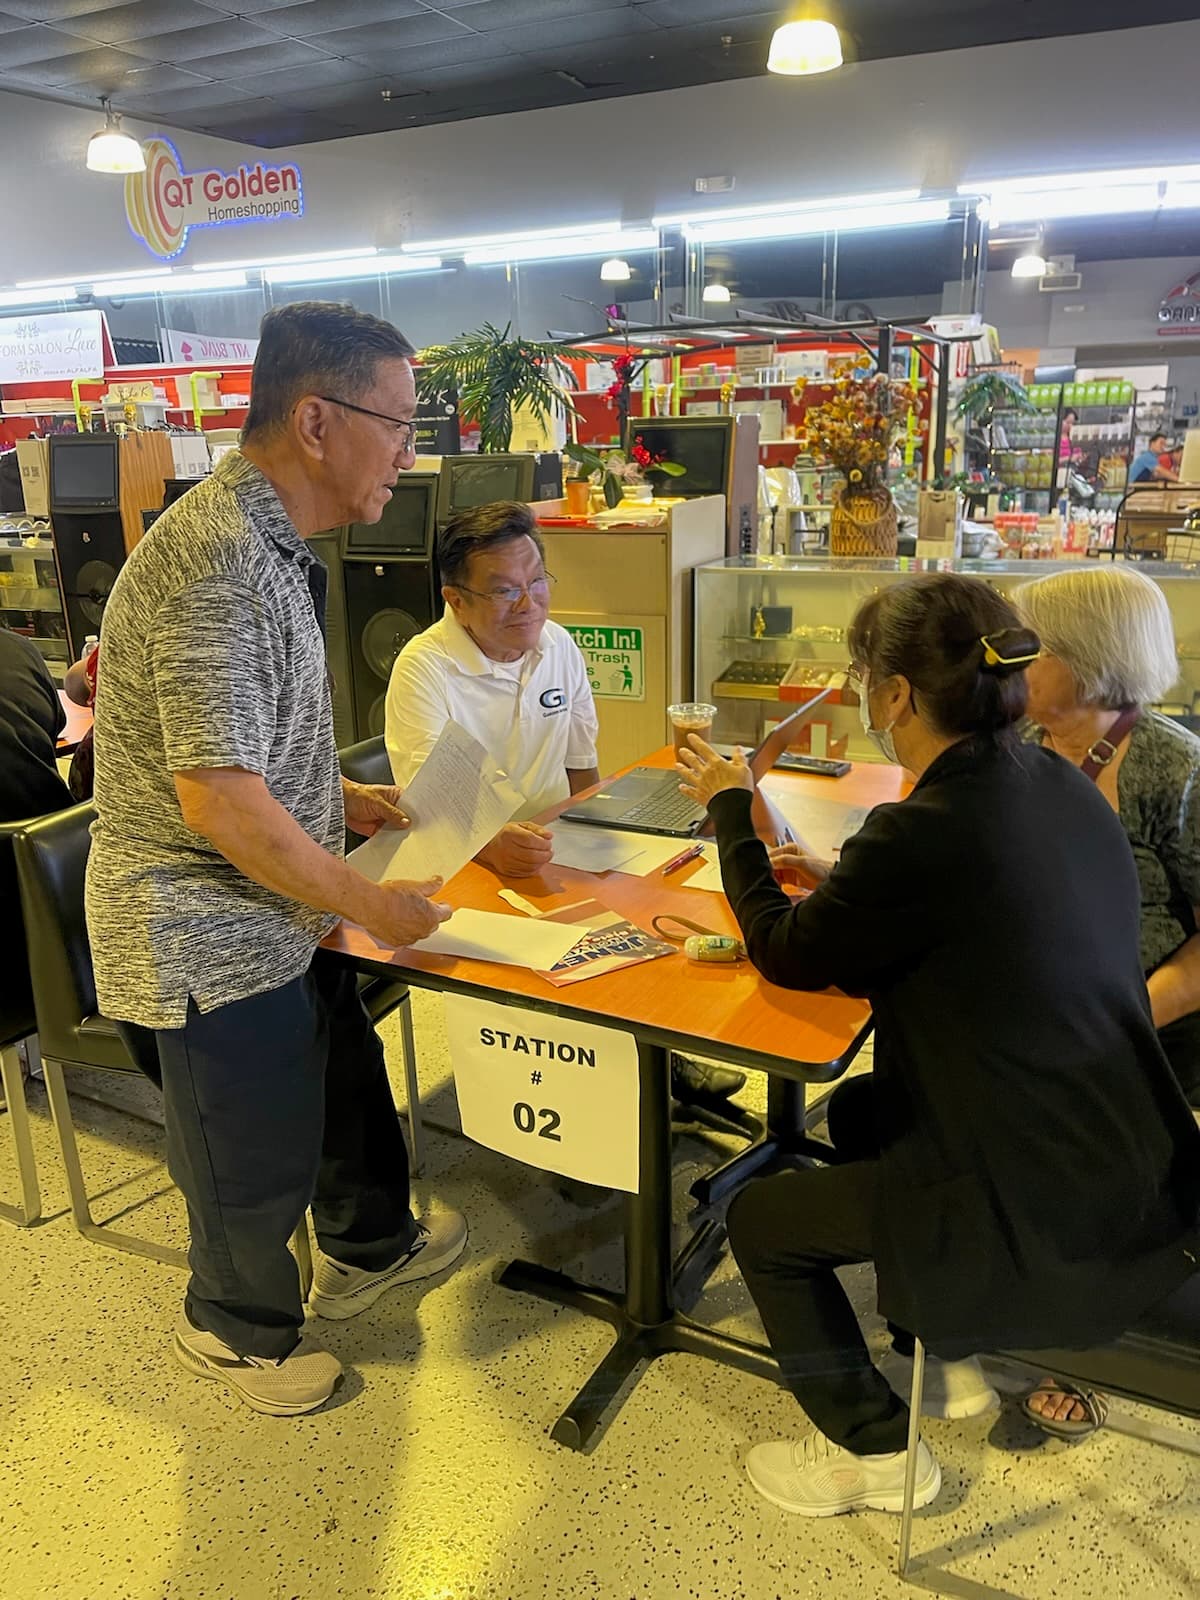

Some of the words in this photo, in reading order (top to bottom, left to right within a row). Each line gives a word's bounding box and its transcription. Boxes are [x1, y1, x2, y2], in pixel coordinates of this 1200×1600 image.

[164, 177, 194, 207] QT
[202, 166, 298, 202] Golden
[208, 199, 299, 221] Homeshopping
[28, 341, 62, 356] SALON
[612, 630, 637, 649] In!
[587, 651, 631, 664] Trash
[480, 1027, 596, 1068] STATION
[531, 1070, 542, 1086] #
[513, 1102, 561, 1142] 02
